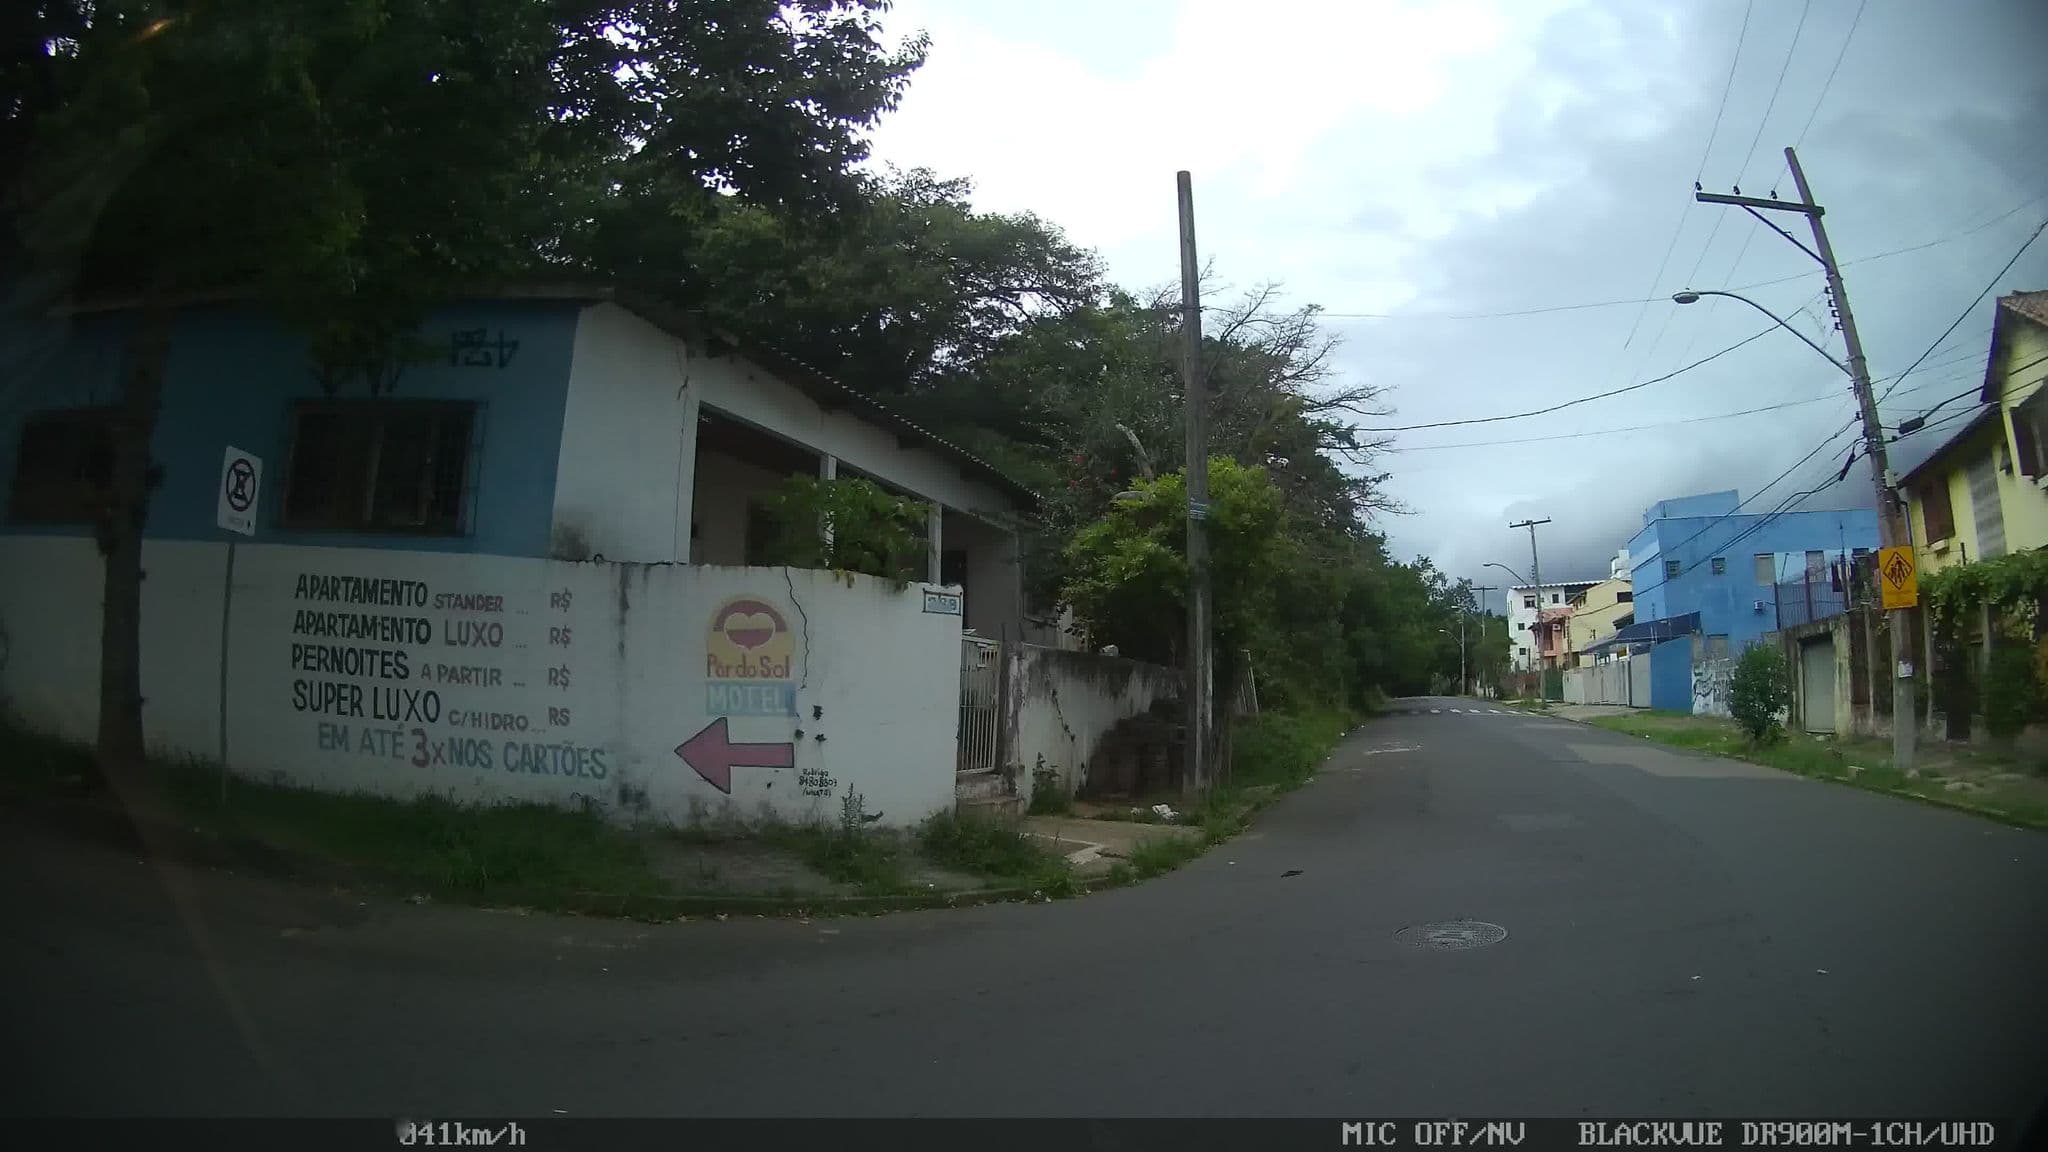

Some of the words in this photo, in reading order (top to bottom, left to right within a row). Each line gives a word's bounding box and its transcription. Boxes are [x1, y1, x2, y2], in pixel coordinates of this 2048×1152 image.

[295, 572, 428, 607] APARTAMENTO
[432, 593, 504, 613] STANDER
[550, 587, 572, 612] R$
[292, 609, 432, 645] APARTAMENTO
[444, 621, 504, 648] LUXO
[549, 625, 571, 648] R$
[291, 643, 410, 680] PERNOITES
[421, 665, 431, 681] A
[437, 663, 502, 688] PARTIR
[548, 664, 571, 691] R$
[758, 655, 790, 678] Sol
[292, 679, 364, 718] SUPER
[373, 687, 441, 723] LUXO
[709, 684, 788, 713] MOTEL
[318, 722, 349, 752] EM
[360, 723, 405, 760] ATÉ
[503, 741, 607, 780] CARTÕES
